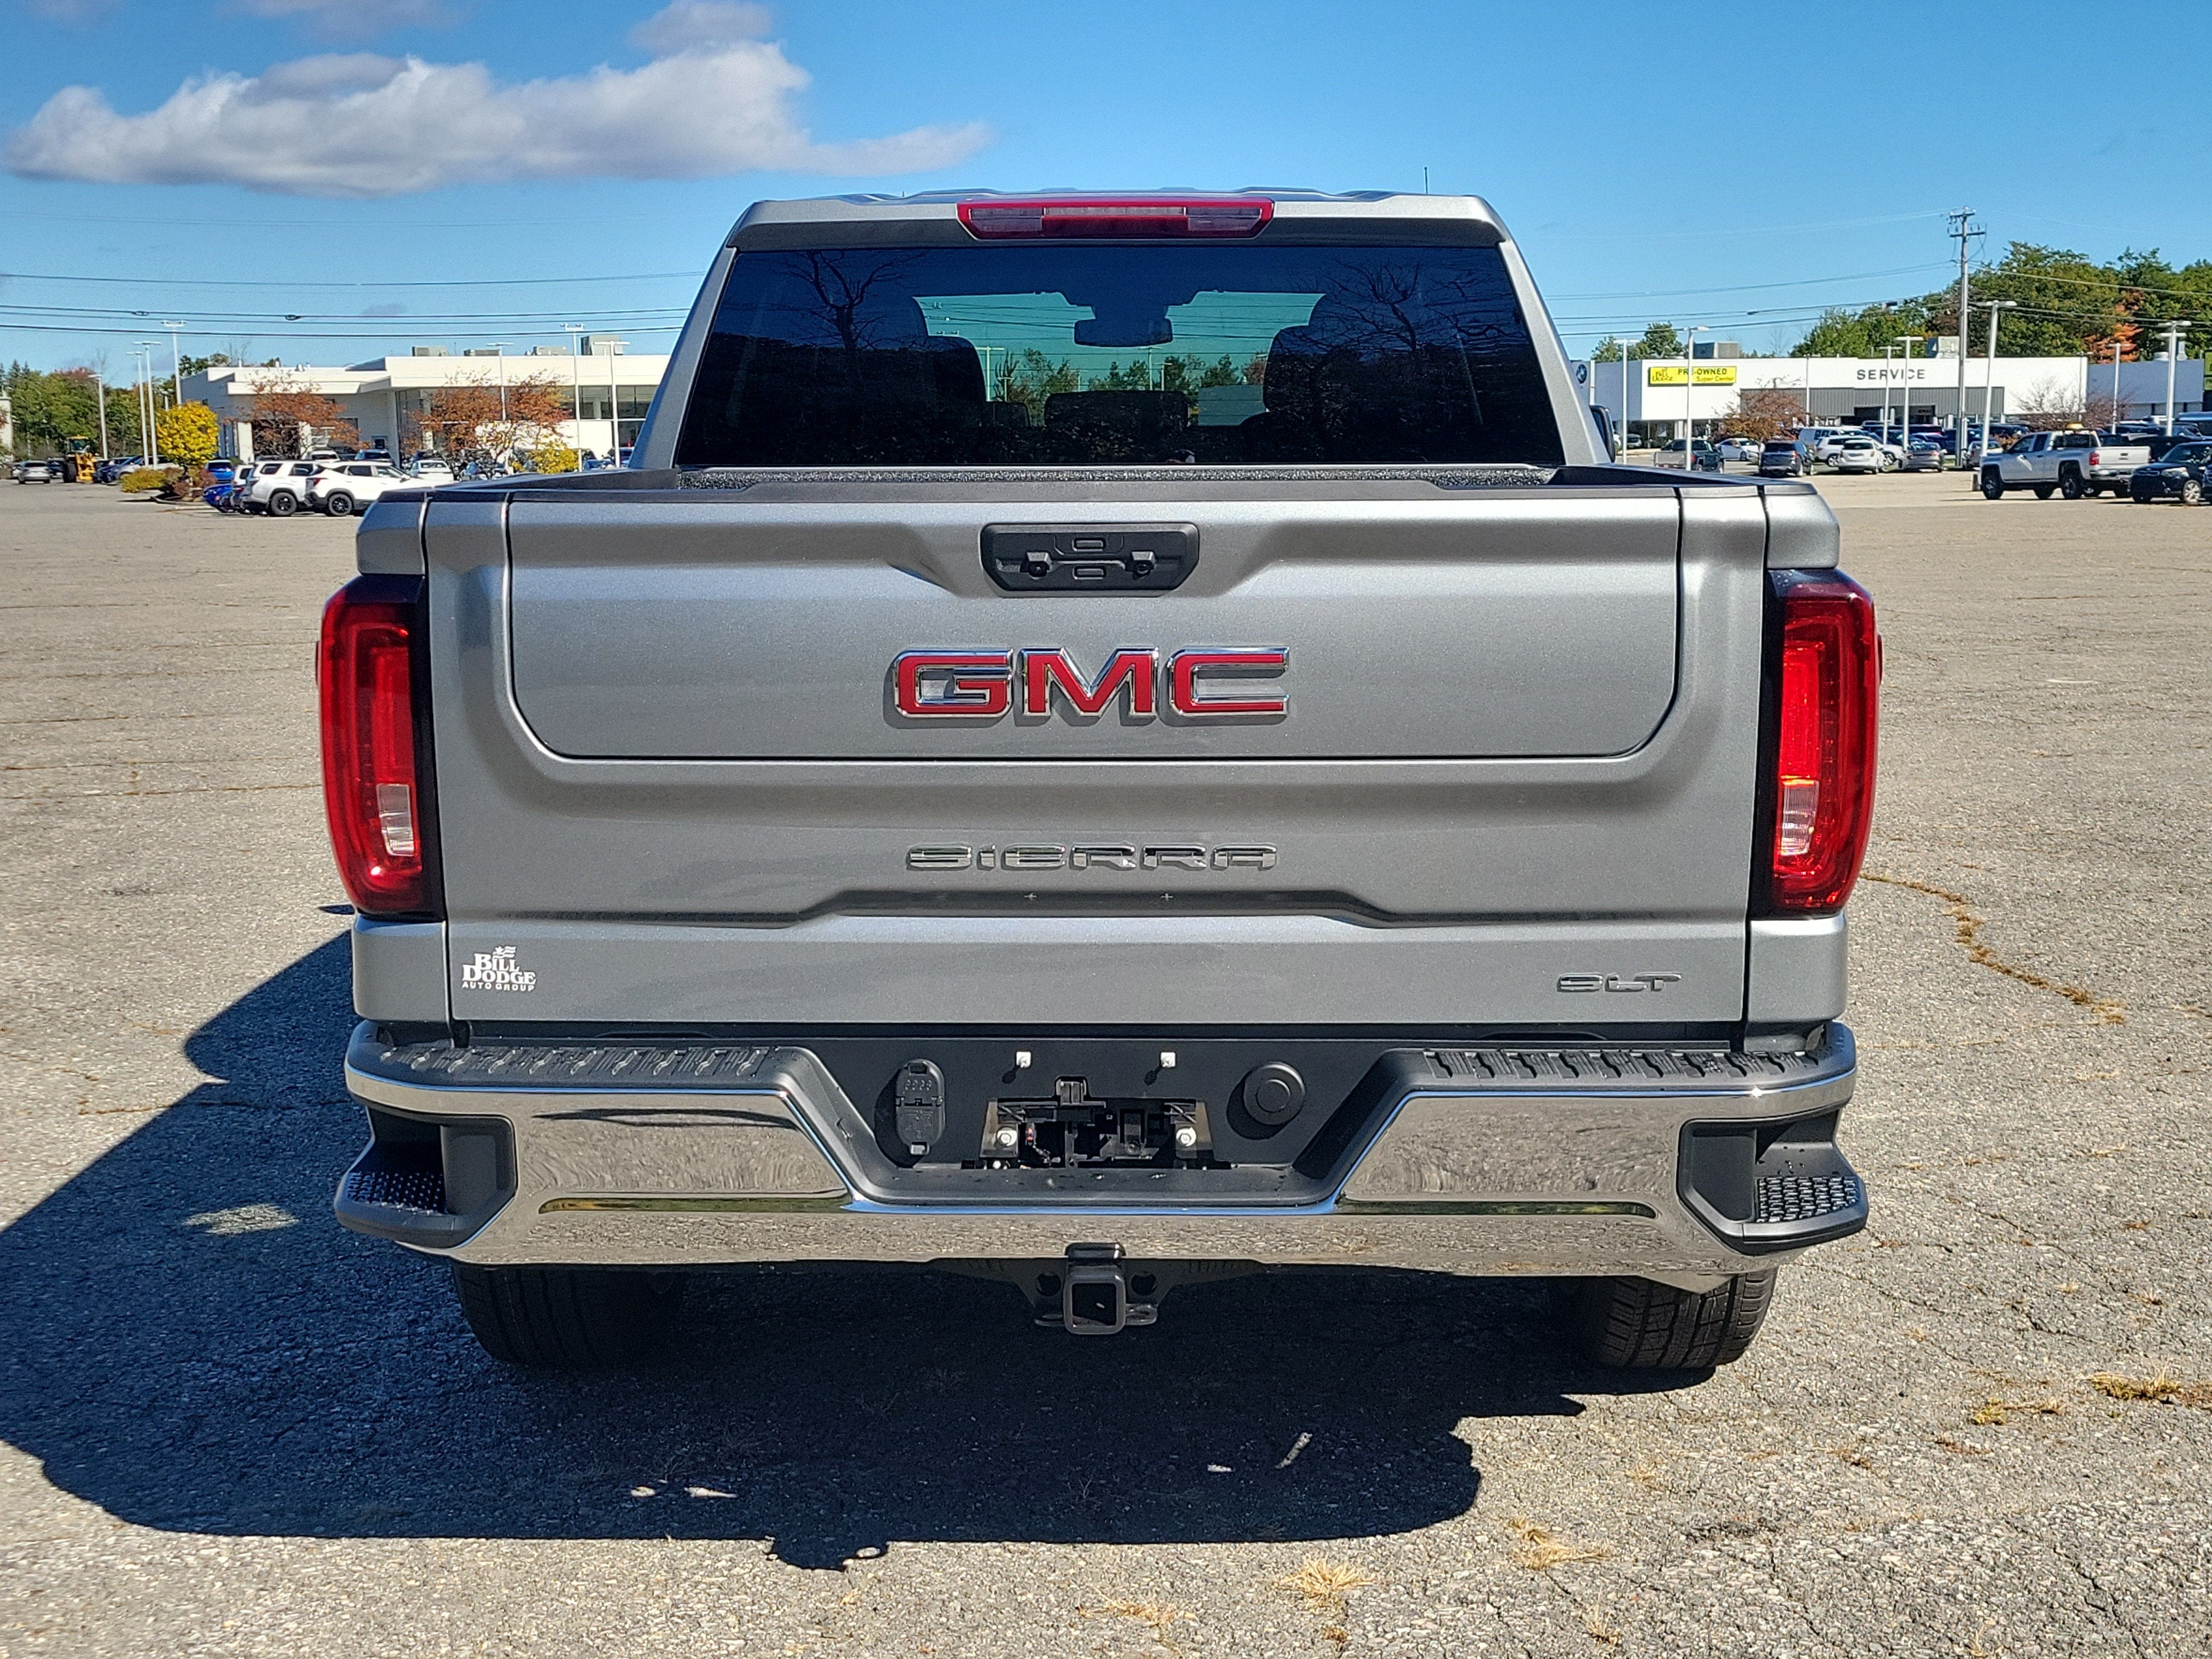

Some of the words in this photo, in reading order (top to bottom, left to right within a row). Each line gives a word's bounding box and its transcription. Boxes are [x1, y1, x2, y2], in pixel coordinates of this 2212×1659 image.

[1857, 369, 1926, 380] SERVICE
[893, 647, 1290, 718] GMC
[908, 845, 1277, 869] SIERRA
[474, 953, 520, 972] BILL
[462, 964, 537, 985] DODGE
[1558, 972, 1681, 992] SLT
[462, 981, 492, 990] AUTO
[495, 983, 535, 992] GROUP
